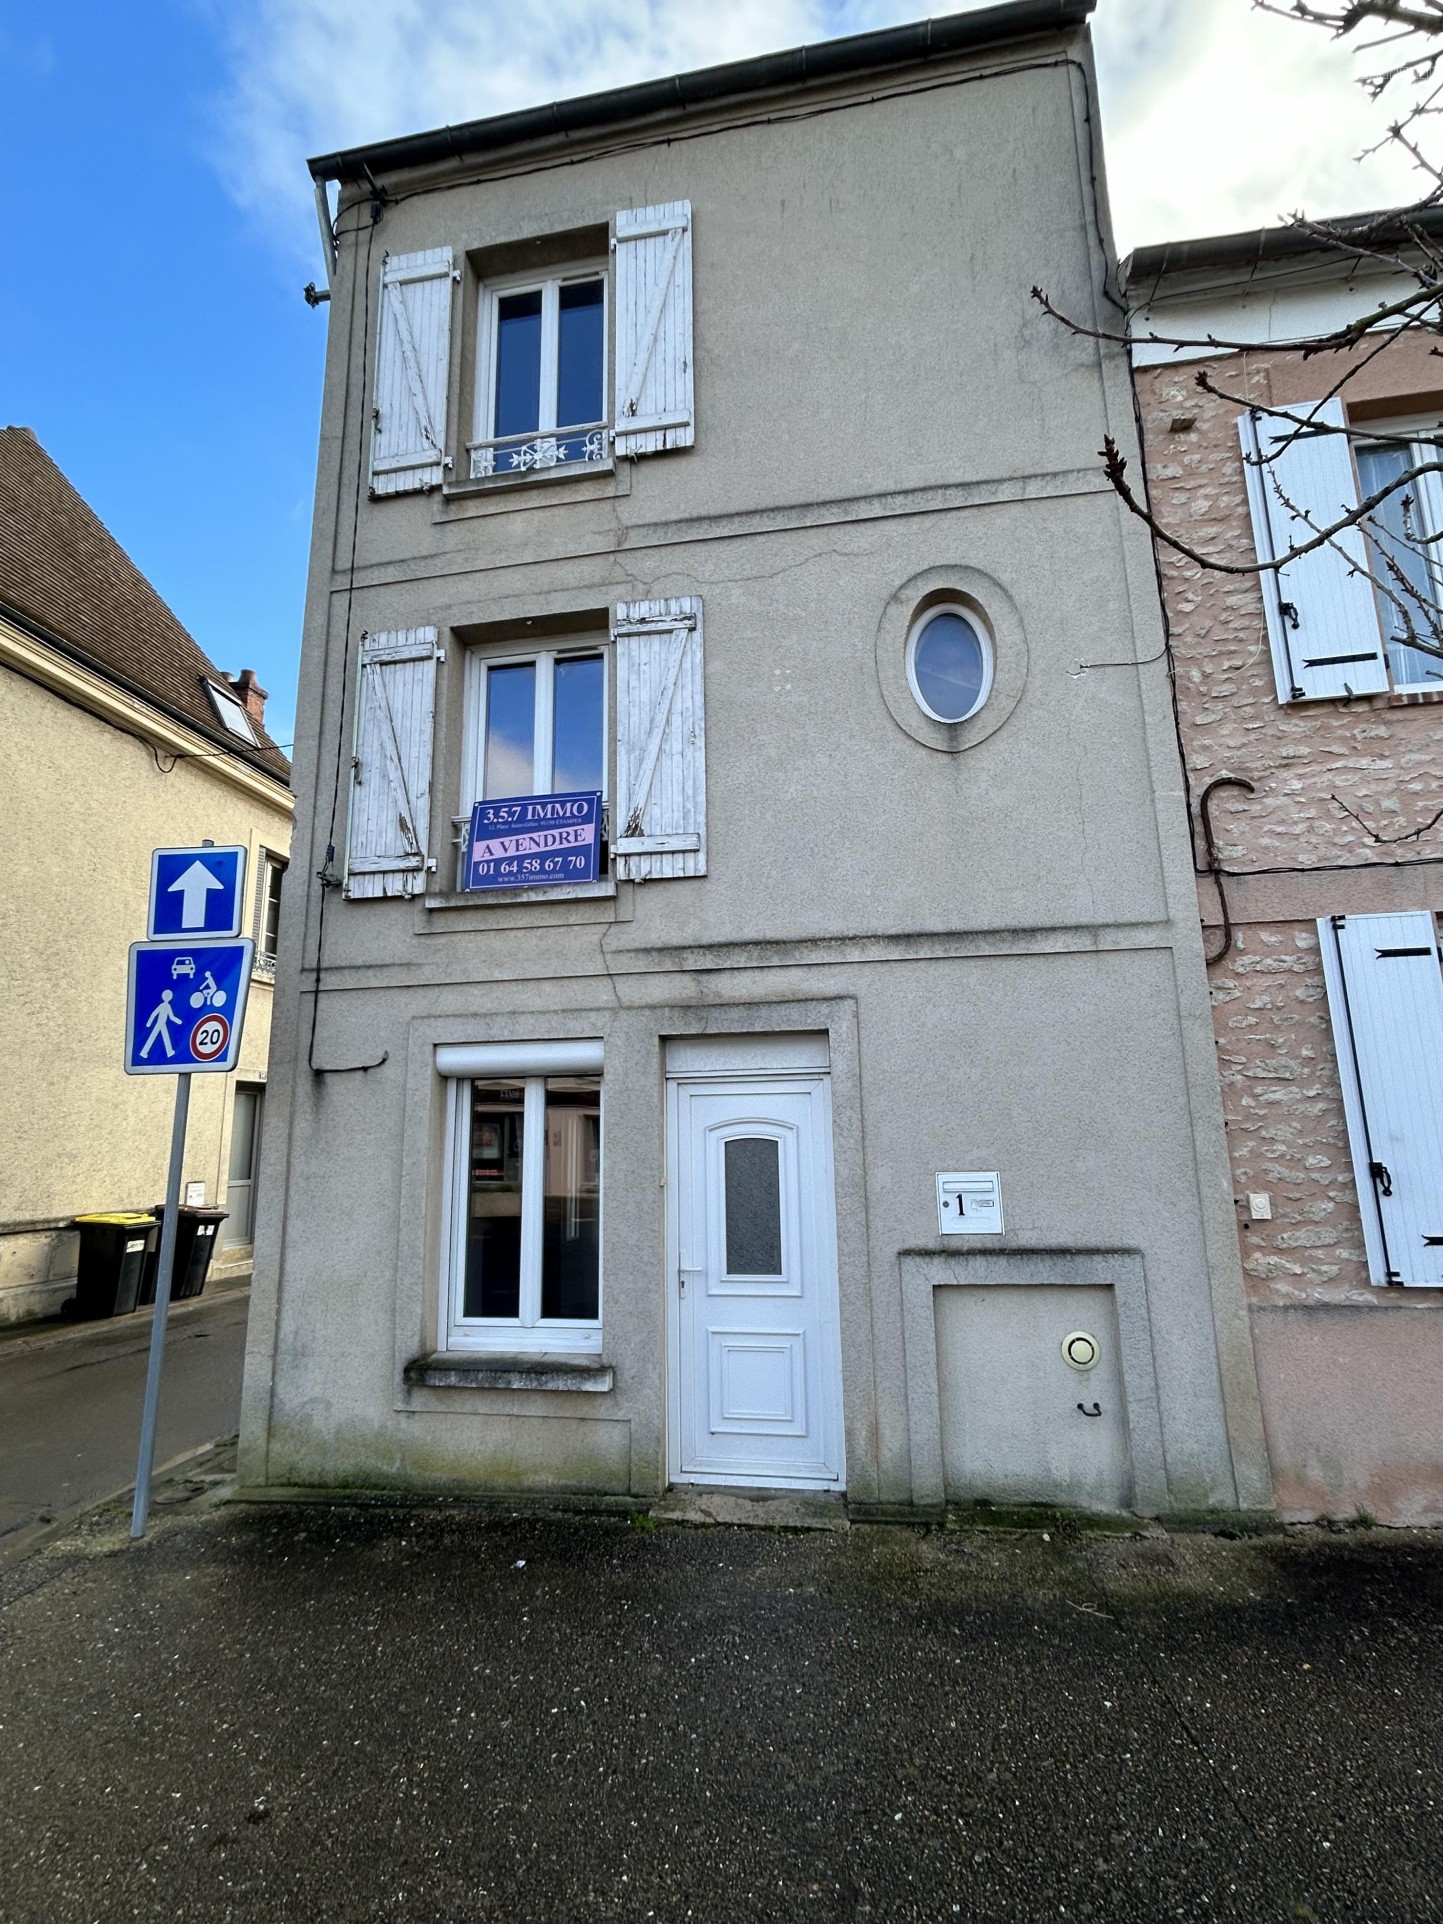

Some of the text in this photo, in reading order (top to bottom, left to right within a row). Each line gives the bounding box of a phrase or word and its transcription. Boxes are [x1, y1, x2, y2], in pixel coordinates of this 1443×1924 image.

[483, 801, 589, 824] 3.5.7 IMMO
[481, 828, 586, 858] A VENDRE
[478, 855, 585, 875] 01 64 58 67 70
[498, 873, 564, 882] www.357immo.com
[199, 1029, 220, 1046] 20
[956, 1193, 965, 1216] 1
